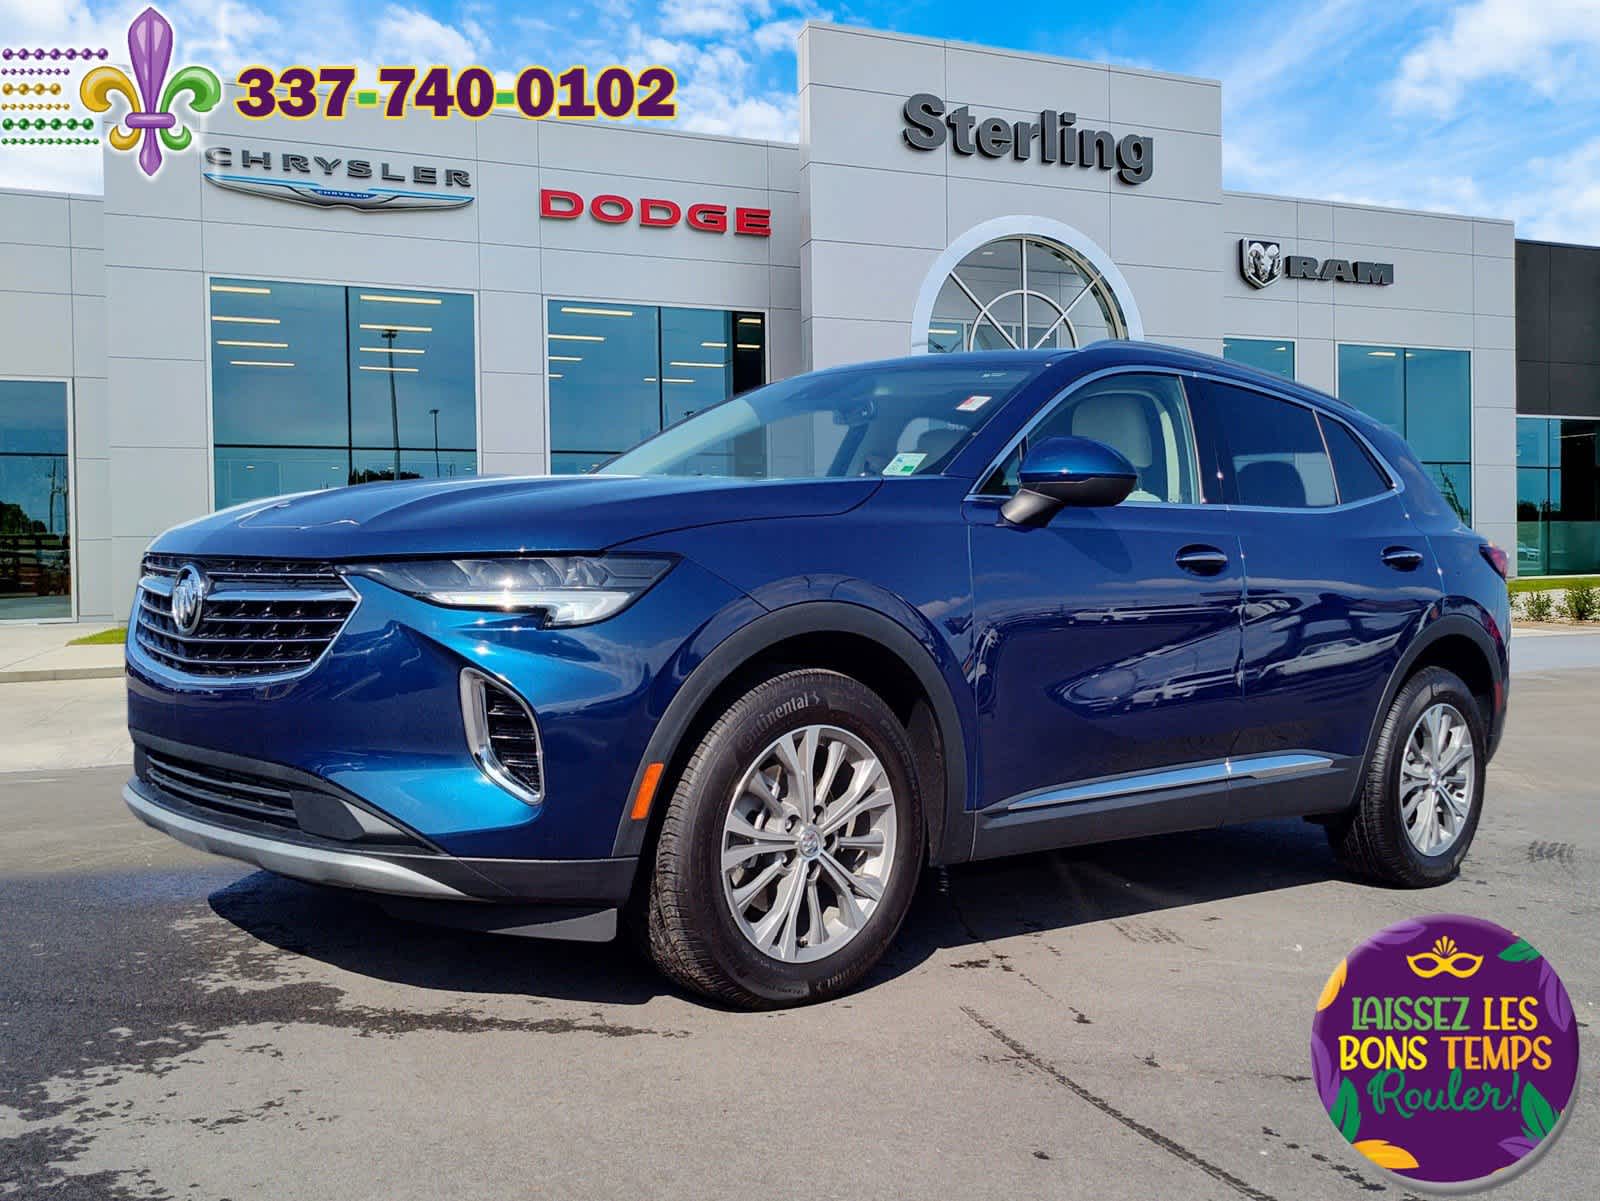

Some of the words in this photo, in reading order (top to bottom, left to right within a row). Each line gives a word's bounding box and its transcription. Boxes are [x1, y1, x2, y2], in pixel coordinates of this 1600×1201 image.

[903, 92, 1154, 185] Sterling
[204, 146, 472, 188] CHRYSLER
[540, 188, 772, 238] DODGE
[1284, 255, 1394, 286] RAM
